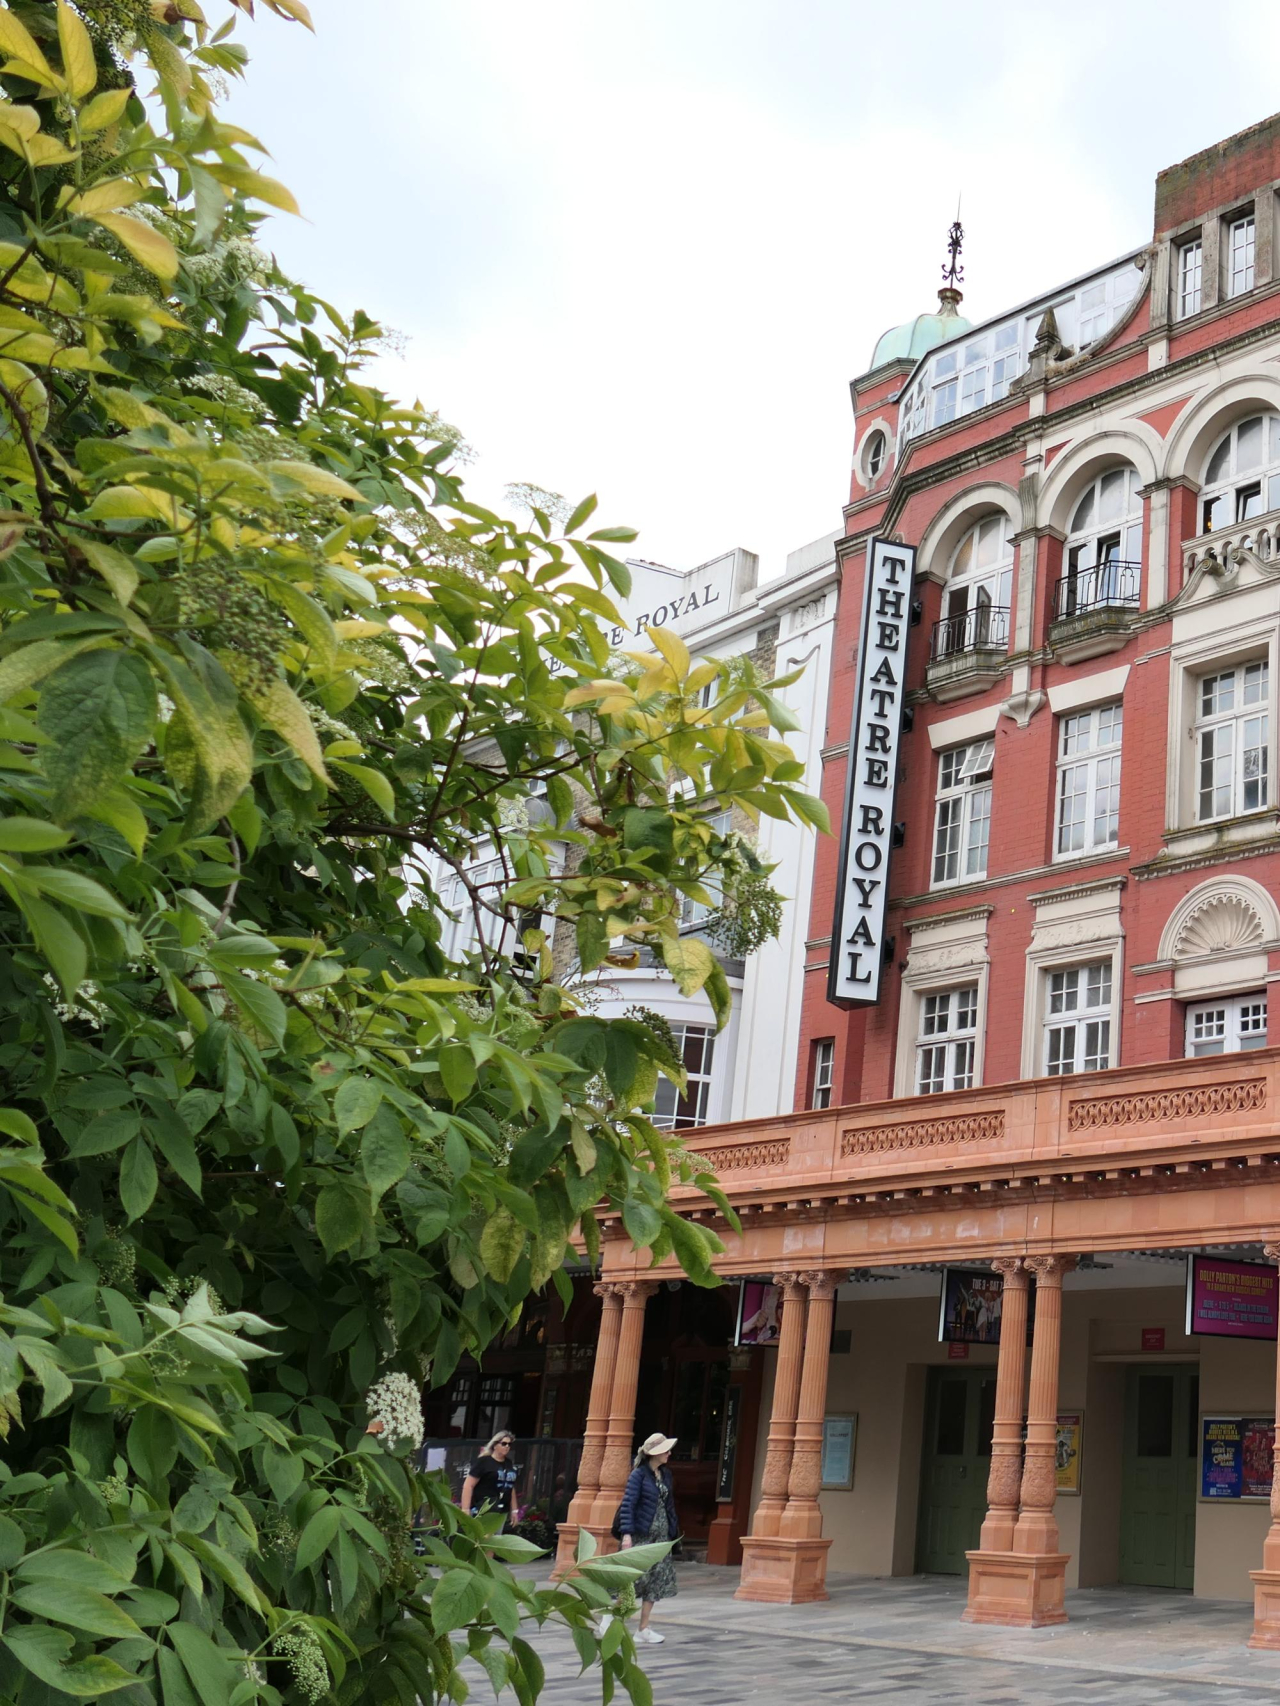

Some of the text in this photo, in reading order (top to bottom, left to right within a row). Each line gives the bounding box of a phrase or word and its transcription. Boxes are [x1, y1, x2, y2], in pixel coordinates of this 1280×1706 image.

[634, 584, 720, 637] ROYAL
[845, 555, 907, 984] THEATRE ROYAL
